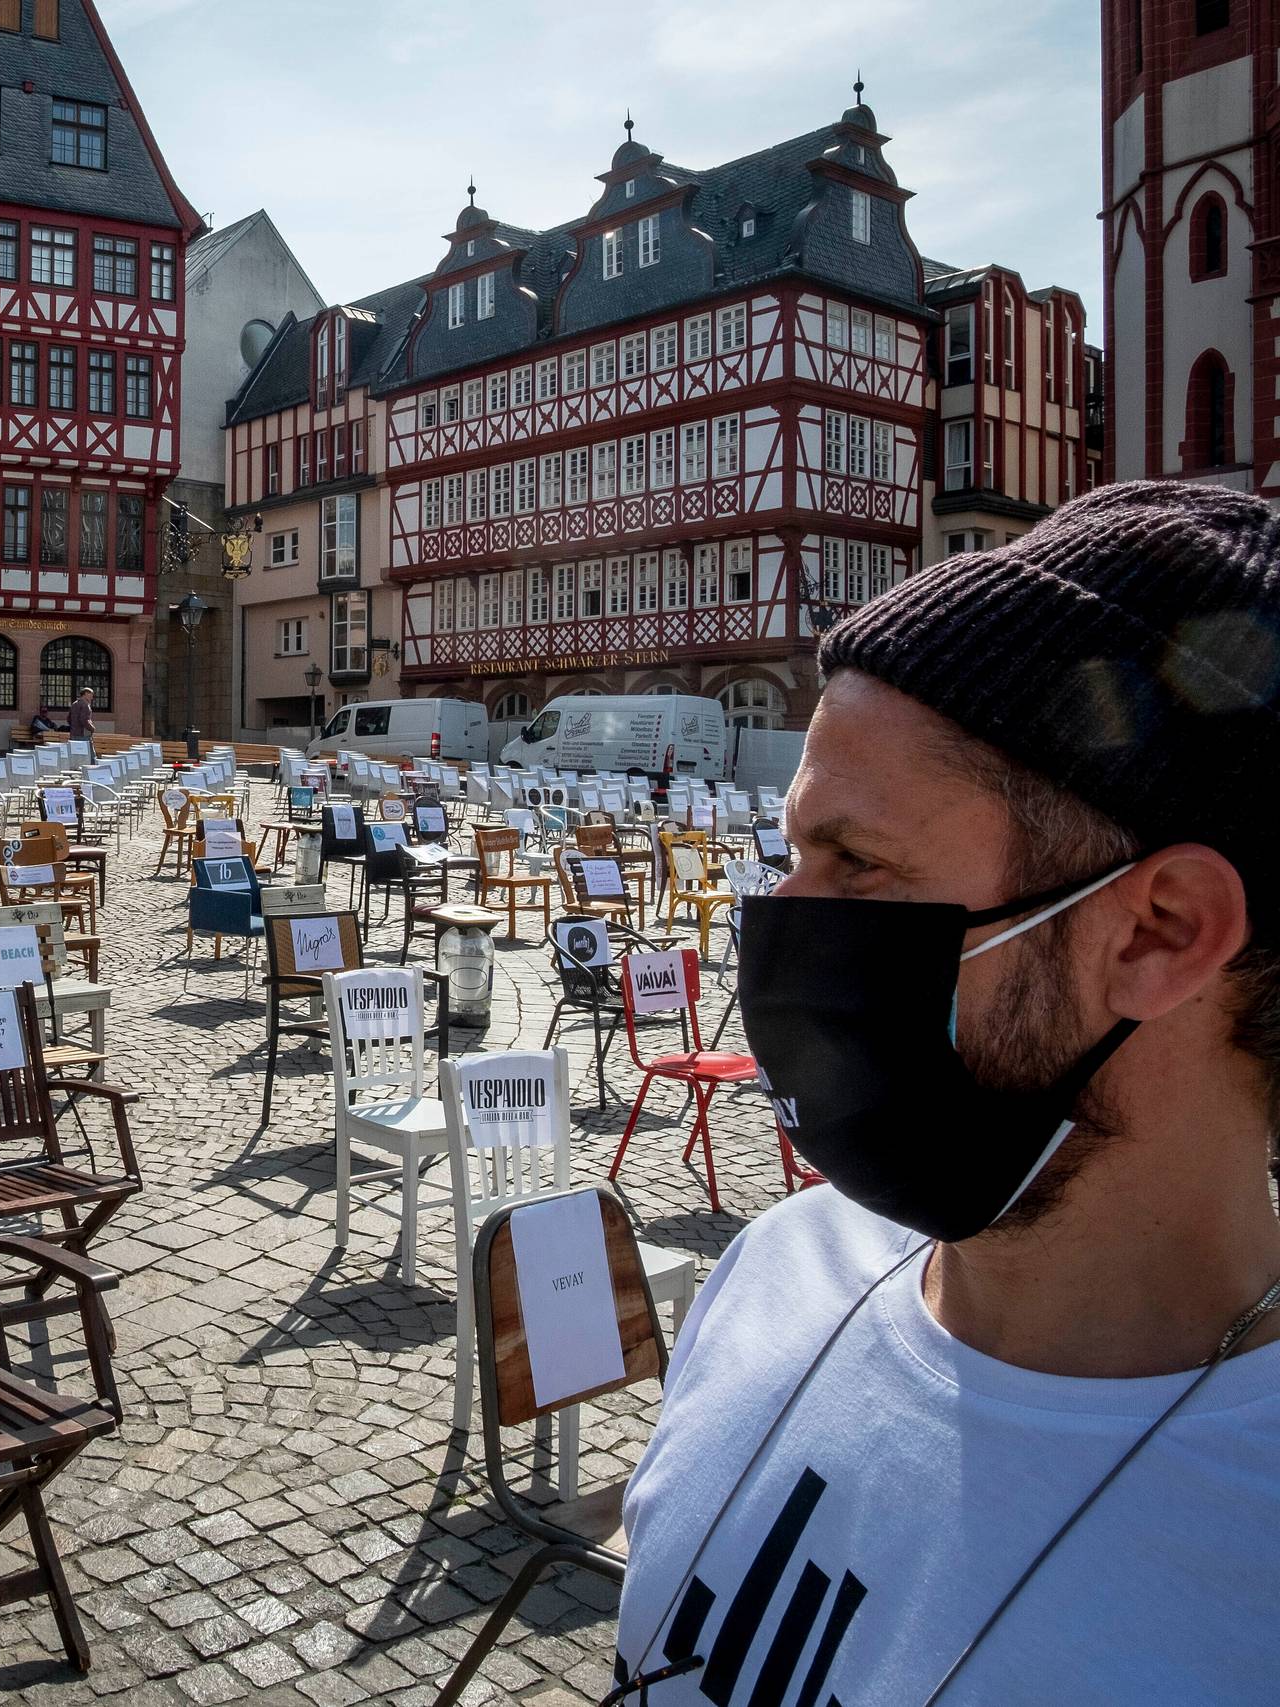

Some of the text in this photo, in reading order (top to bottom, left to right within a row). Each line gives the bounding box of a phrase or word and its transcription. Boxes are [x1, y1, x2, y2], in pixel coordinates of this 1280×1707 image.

[470, 649, 670, 675] RESTAURANT SCHWARZER STERN
[346, 987, 408, 1010] VESPAIOLO
[469, 1078, 546, 1110] VESPAIOLO
[519, 1111, 530, 1120] BAR
[772, 1097, 800, 1127] LY
[552, 1272, 585, 1292] VEVAY
